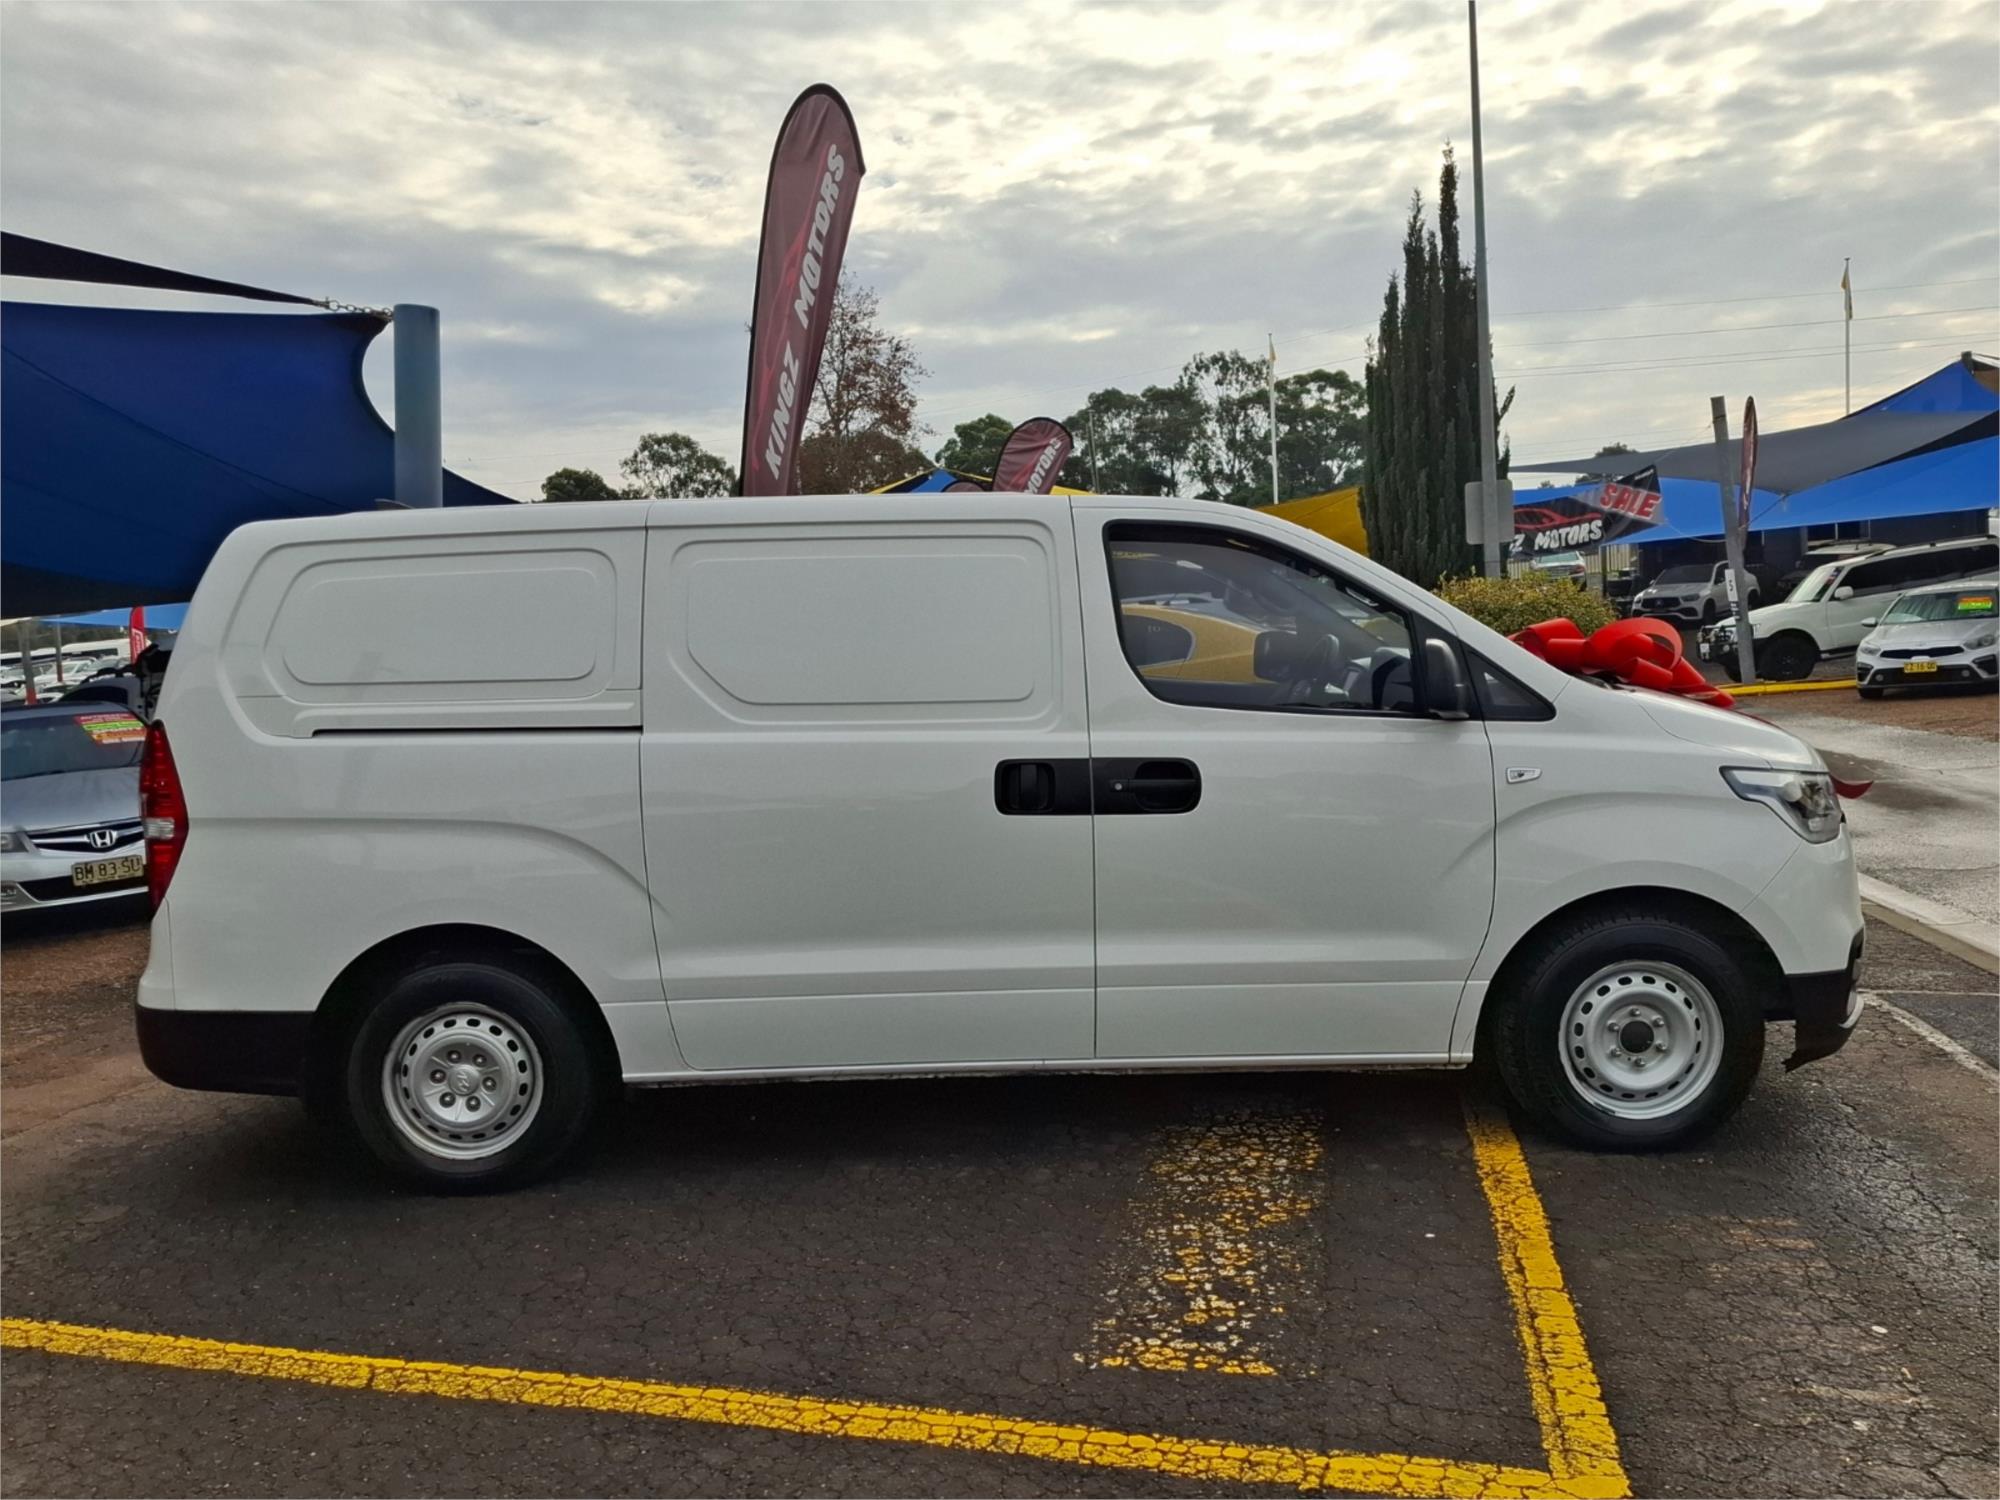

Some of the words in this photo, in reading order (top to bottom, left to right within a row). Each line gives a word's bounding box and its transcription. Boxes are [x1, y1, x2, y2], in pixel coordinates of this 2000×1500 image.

[764, 339, 799, 481] KINGZ
[794, 143, 845, 330] MOTORS
[1600, 482, 1663, 520] SALE
[1534, 519, 1603, 551] MOTORS
